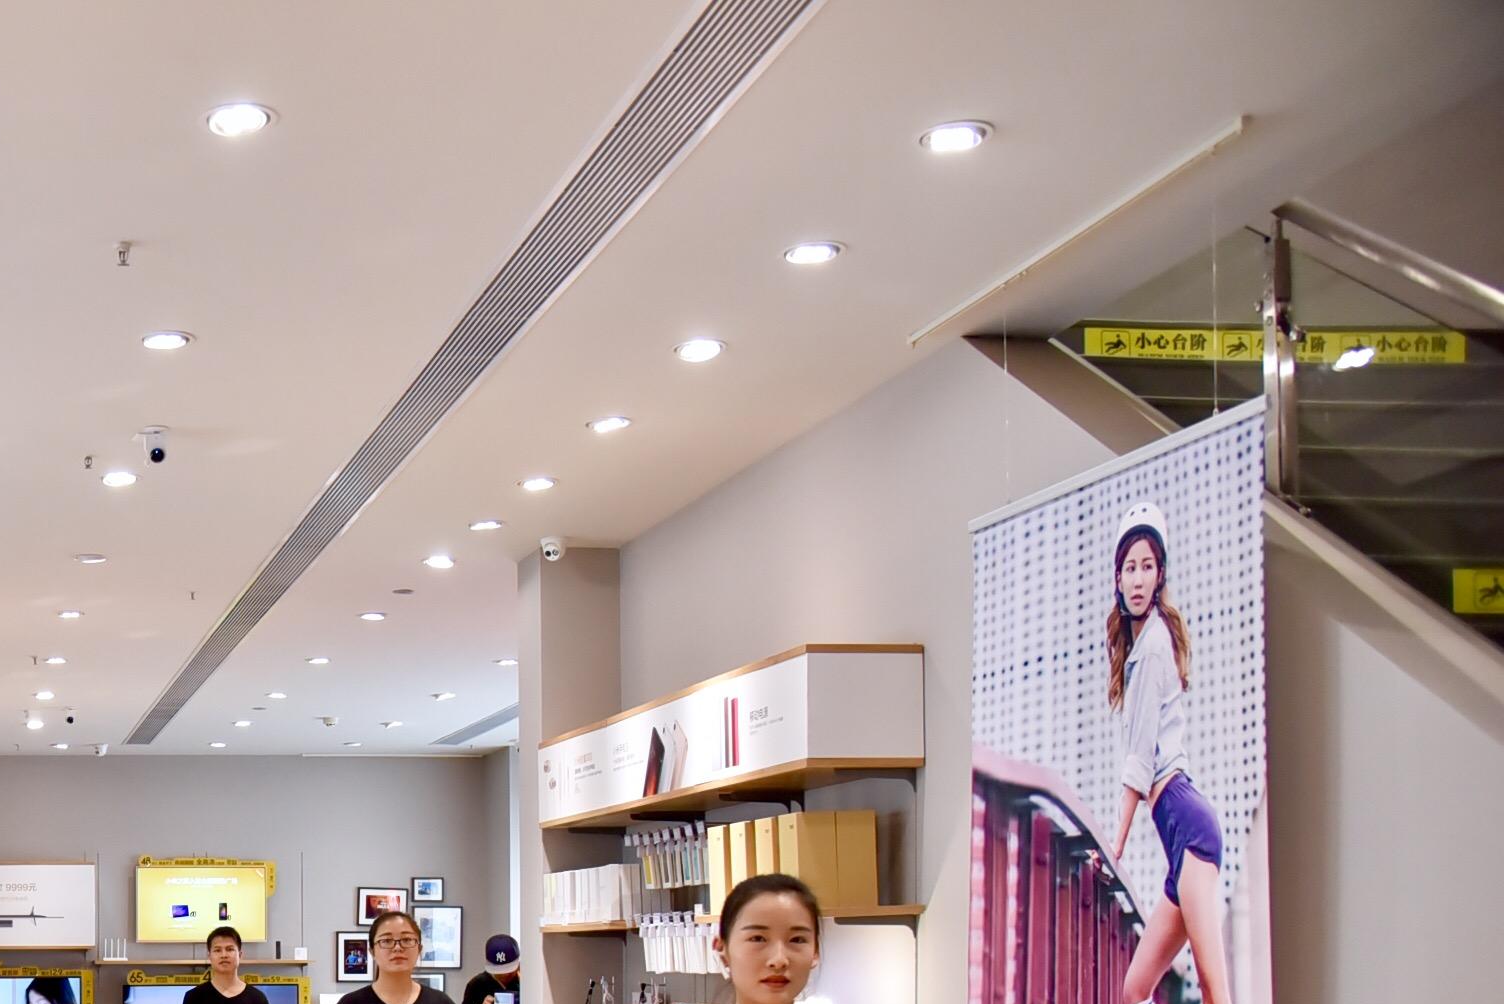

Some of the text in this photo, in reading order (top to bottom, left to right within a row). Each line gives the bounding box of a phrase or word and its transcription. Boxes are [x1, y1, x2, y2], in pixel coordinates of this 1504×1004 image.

[1135, 331, 1207, 352] 小心台阶
[1376, 335, 1449, 353] 小心台阶
[5, 882, 38, 893] 9999元
[495, 951, 506, 963] NY
[129, 972, 144, 983] 65
